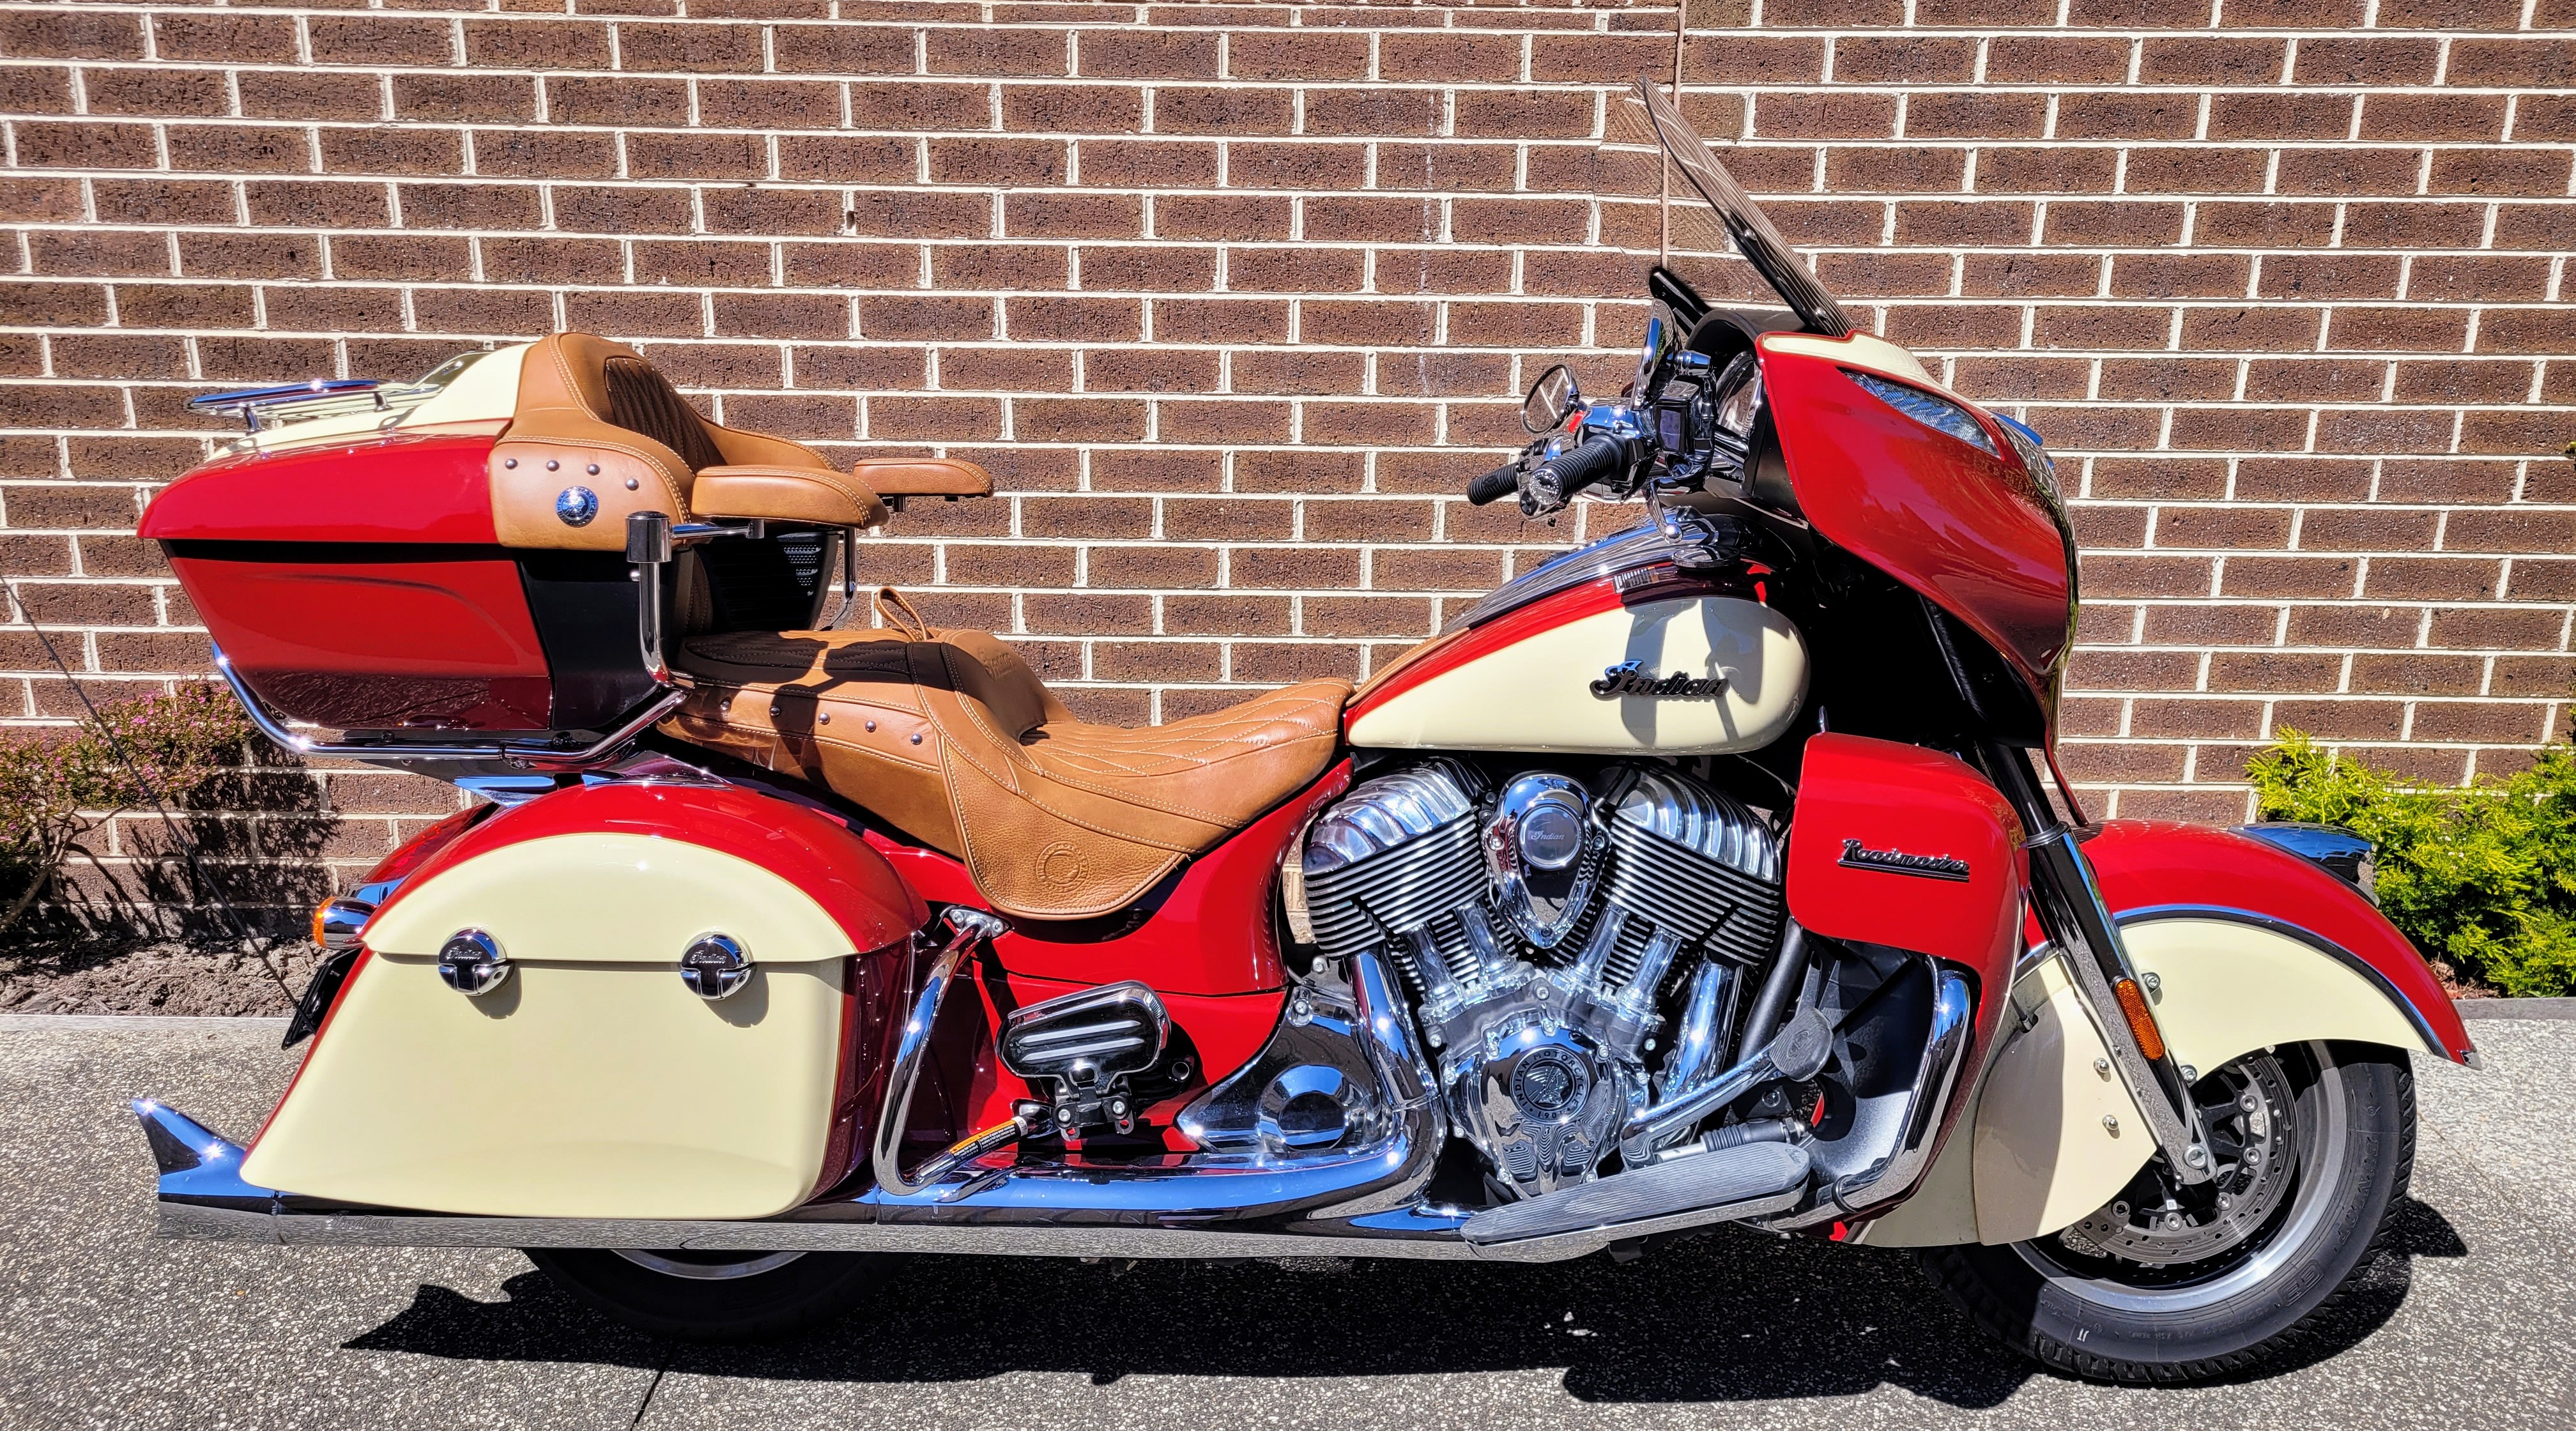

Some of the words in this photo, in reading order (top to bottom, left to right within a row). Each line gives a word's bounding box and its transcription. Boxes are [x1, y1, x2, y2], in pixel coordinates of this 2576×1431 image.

[1590, 660, 1730, 700] Indian
[1531, 830, 1565, 840] Indian
[1837, 838, 1970, 874] Roadmaster
[1515, 1060, 1529, 1106] INDIAN
[1534, 1051, 1584, 1106] MOTORCYCLE
[324, 1211, 394, 1228] Indian
